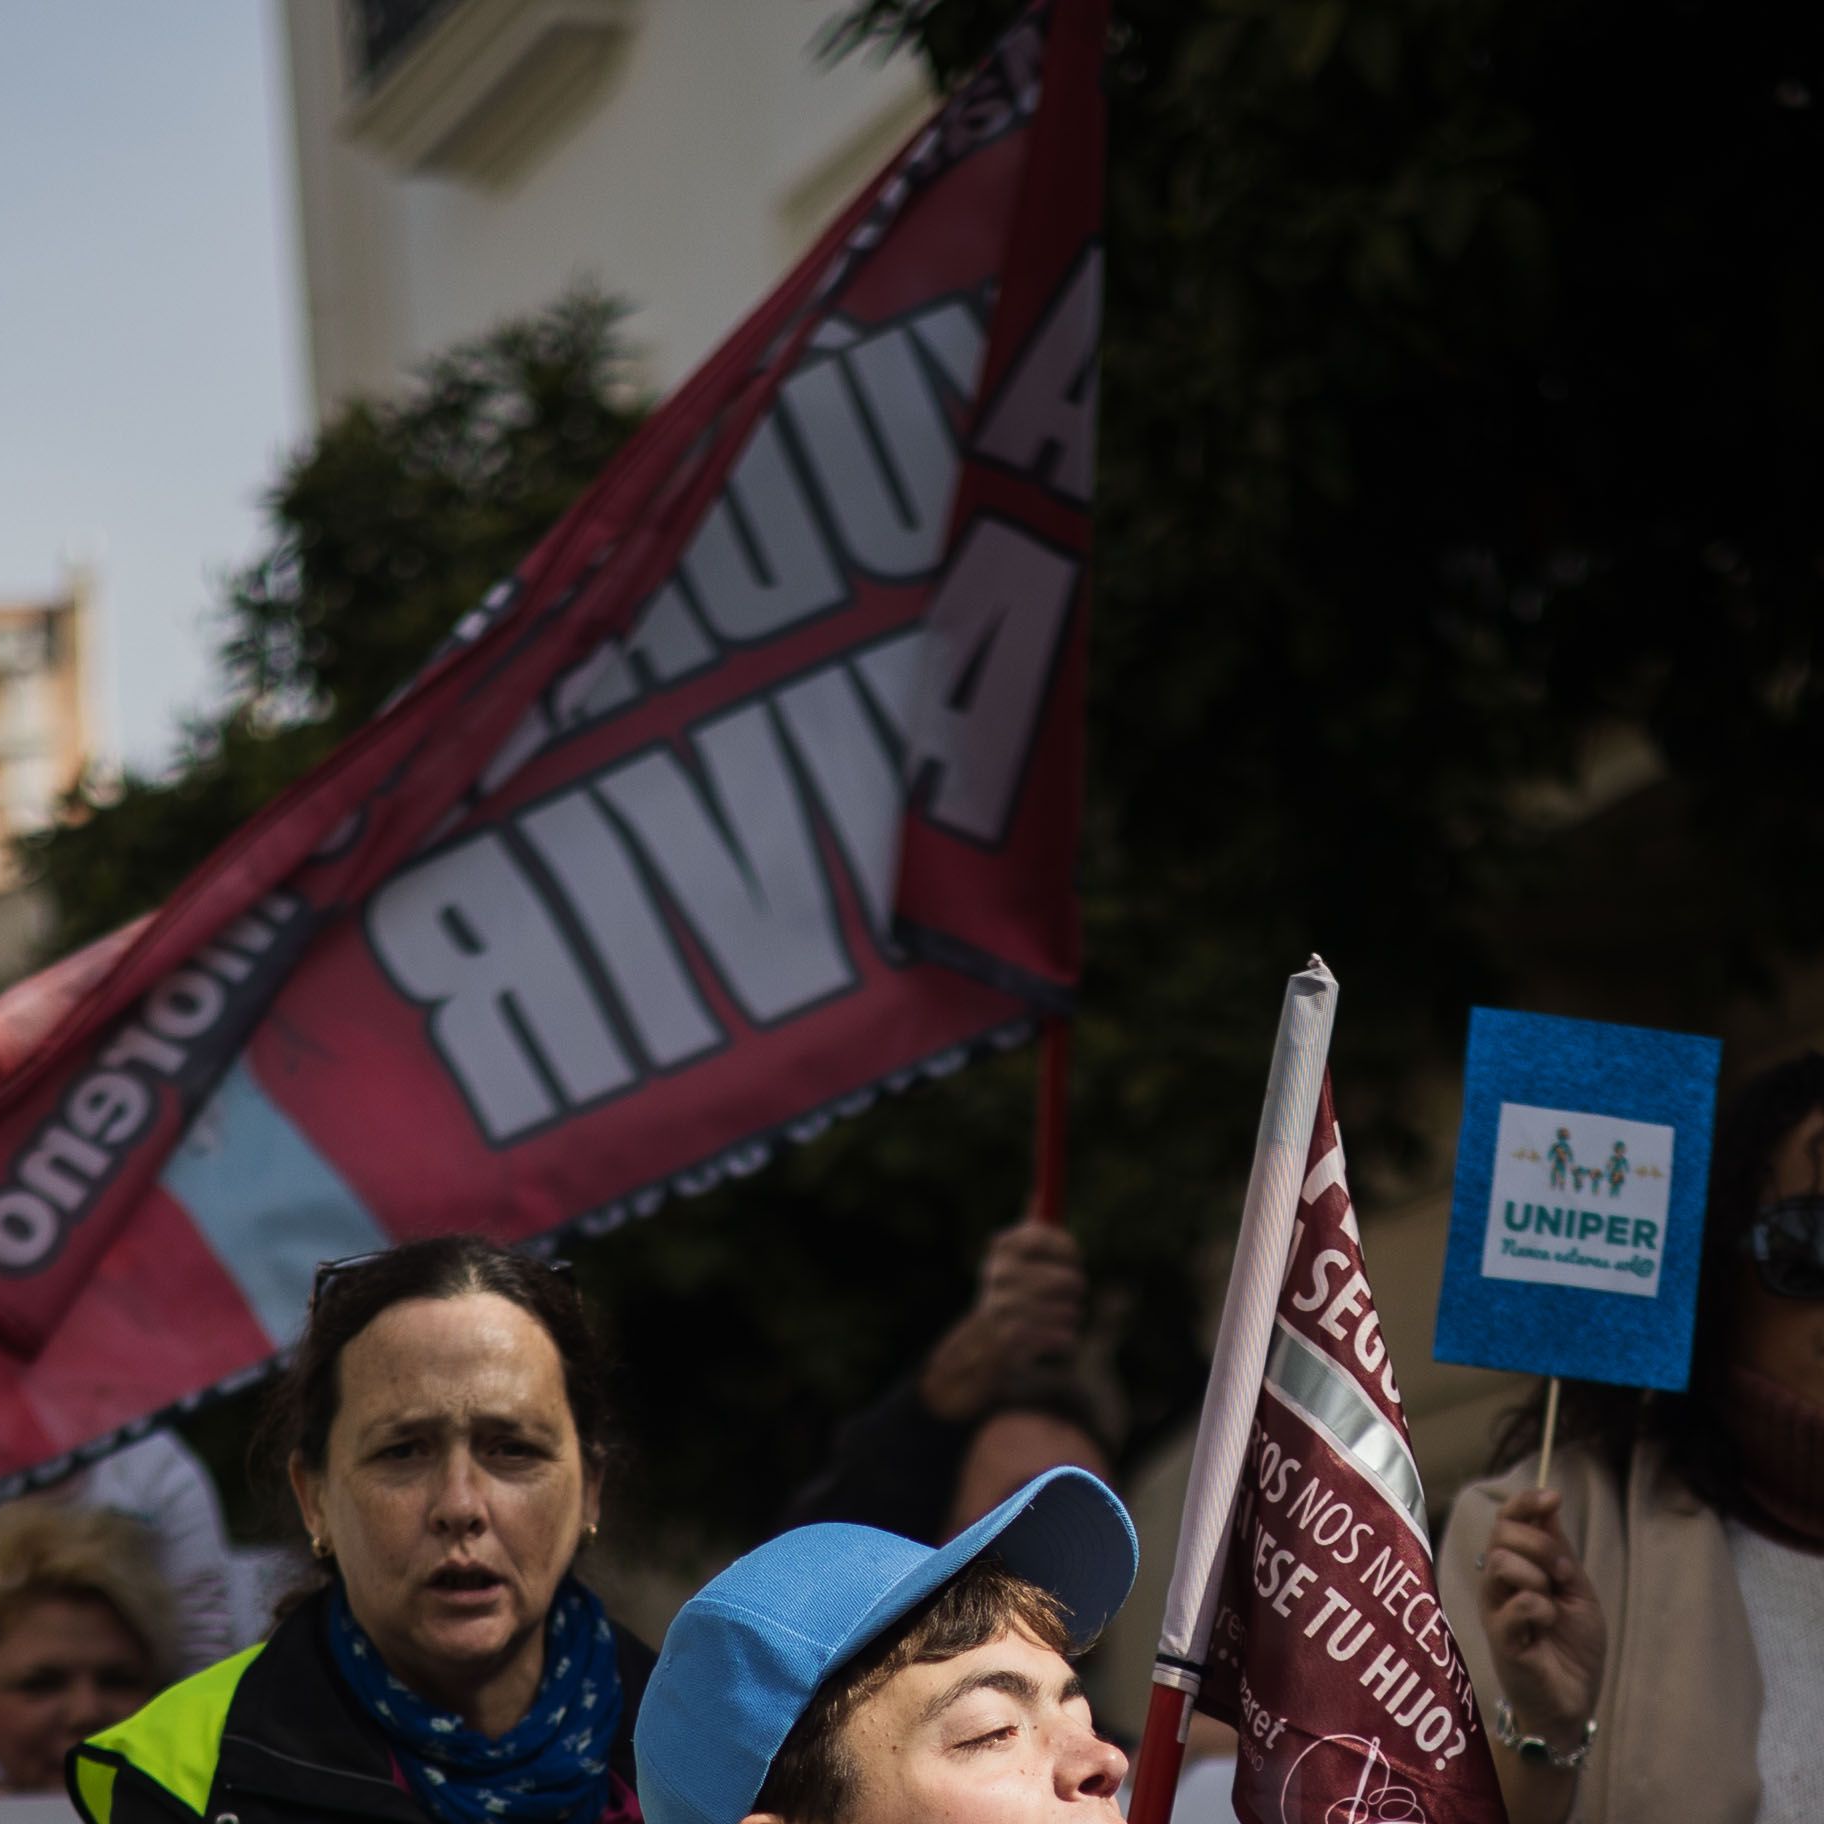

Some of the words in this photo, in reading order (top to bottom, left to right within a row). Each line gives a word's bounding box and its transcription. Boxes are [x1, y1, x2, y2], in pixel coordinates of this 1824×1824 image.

[1502, 1200, 1660, 1251] UNIPER
[1286, 1476, 1375, 1564] NOS
[1359, 1545, 1477, 1734] NECESITA,
[1303, 1586, 1376, 1662] TU
[1359, 1643, 1468, 1772] HIJO?
